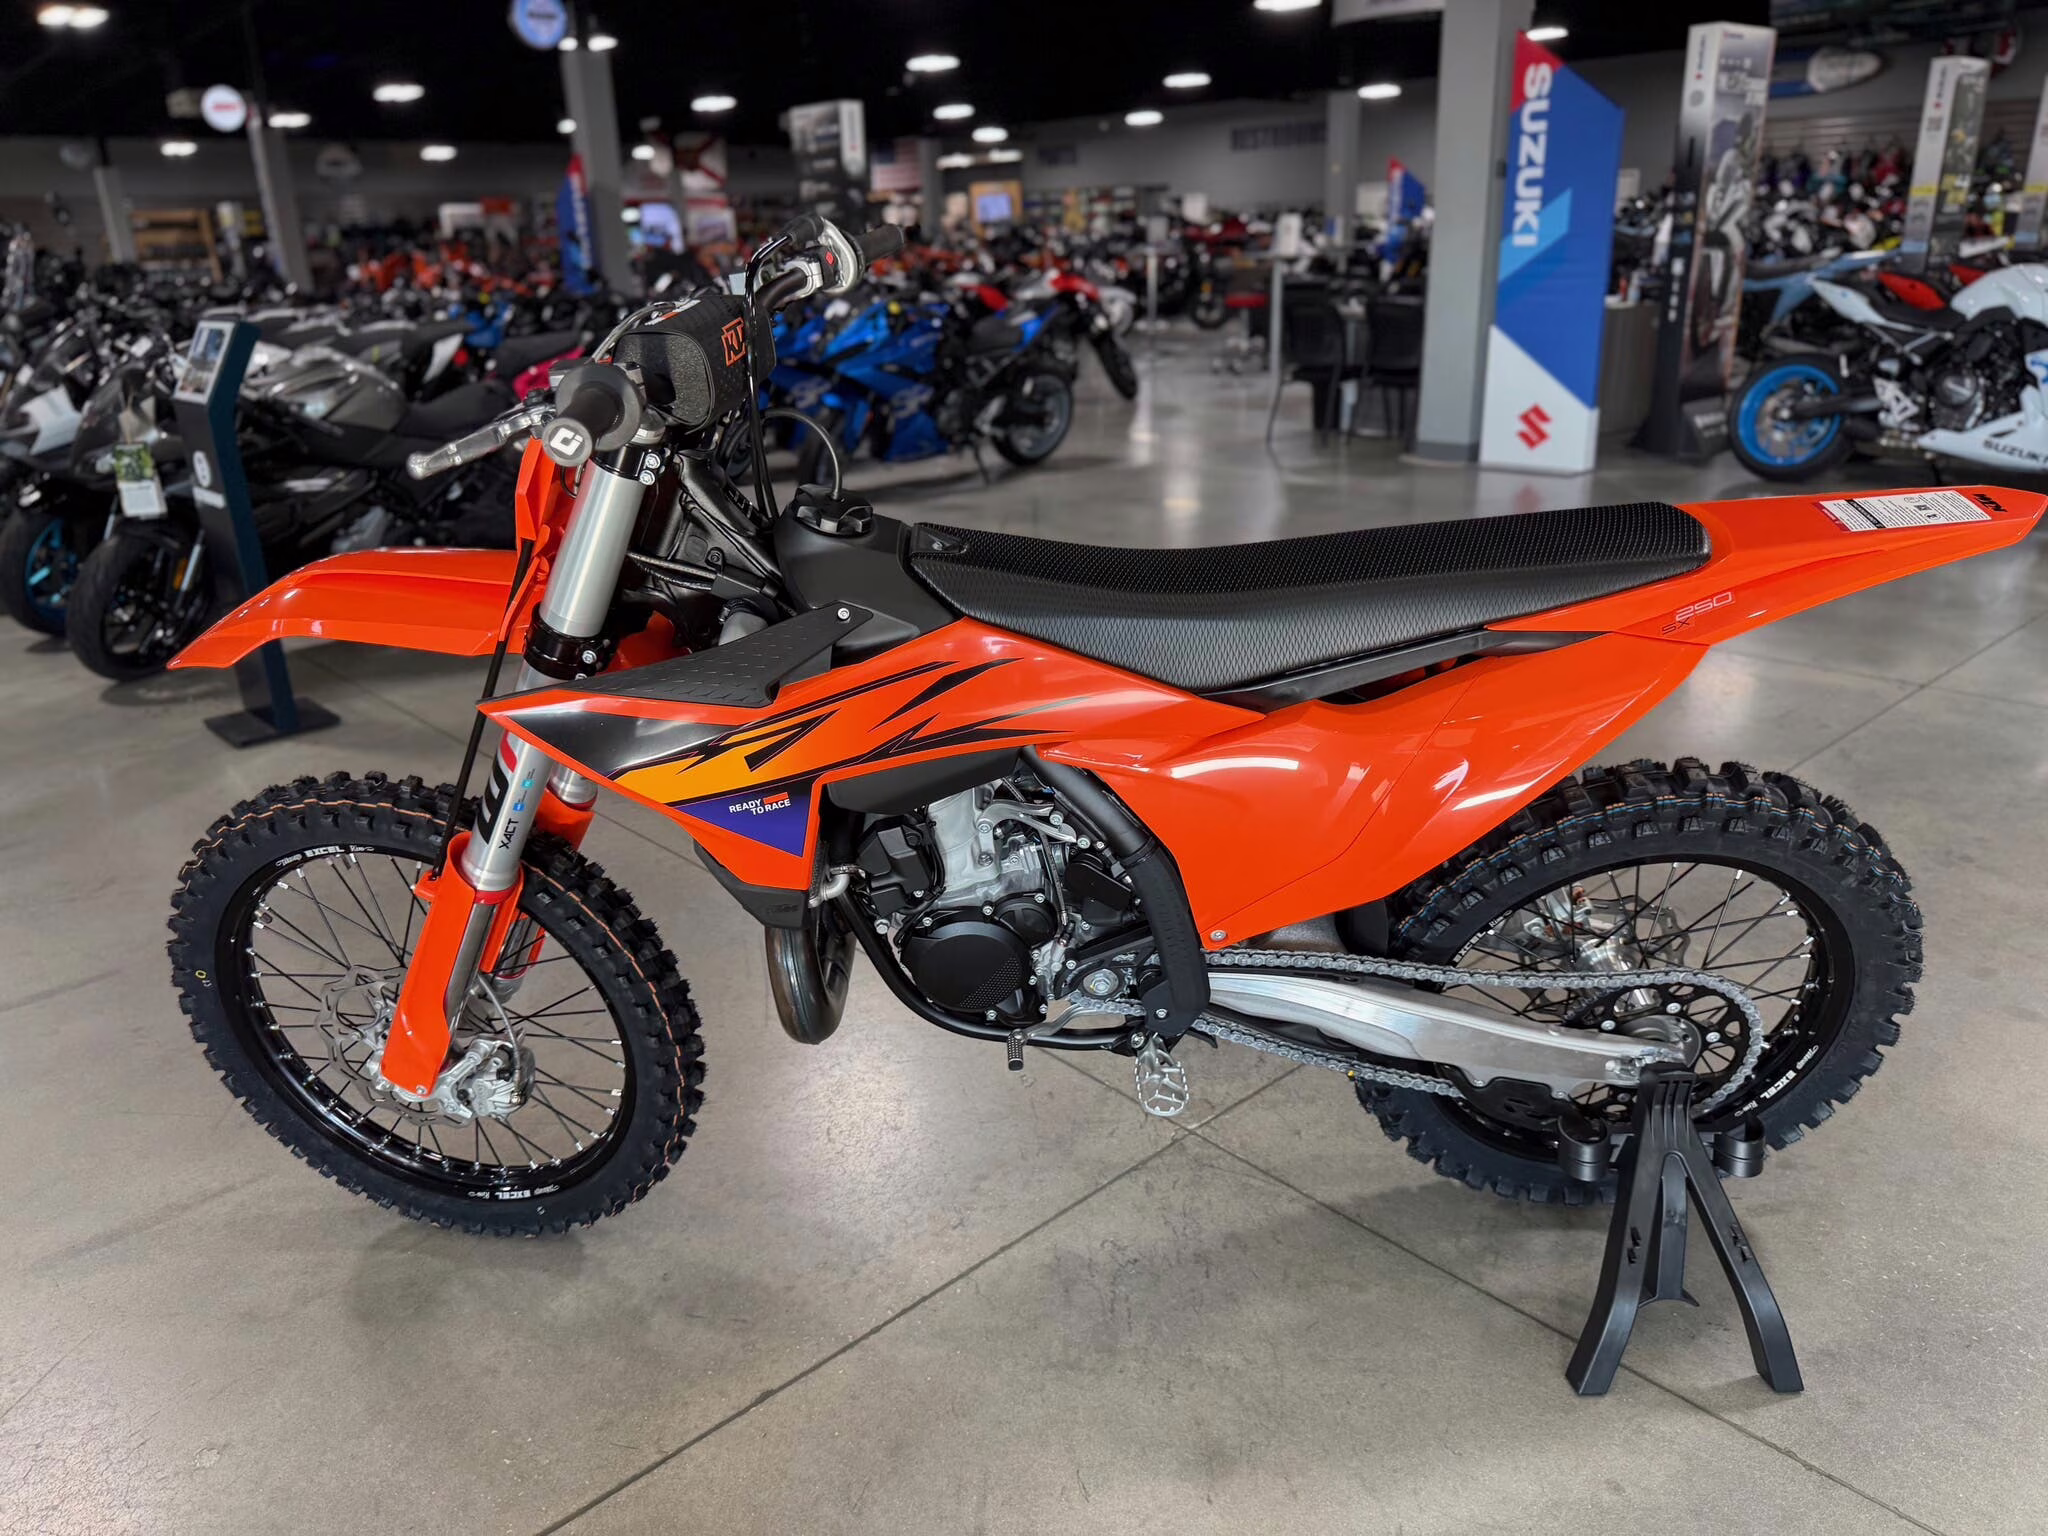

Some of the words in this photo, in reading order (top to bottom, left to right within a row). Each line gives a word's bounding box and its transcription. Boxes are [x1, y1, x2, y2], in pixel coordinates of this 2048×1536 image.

[1512, 62, 1552, 246] SUZUKI
[1676, 591, 1733, 621] 250
[1662, 617, 1690, 635] SX
[728, 798, 761, 813] READY
[750, 806, 764, 815] TO
[764, 798, 791, 812] RACE
[498, 818, 519, 850] XACT
[304, 845, 345, 857] EXCEL
[1452, 931, 1486, 962] EXCEL
[1760, 1070, 1797, 1099] EXCEL
[495, 1189, 531, 1200] EXCEL
